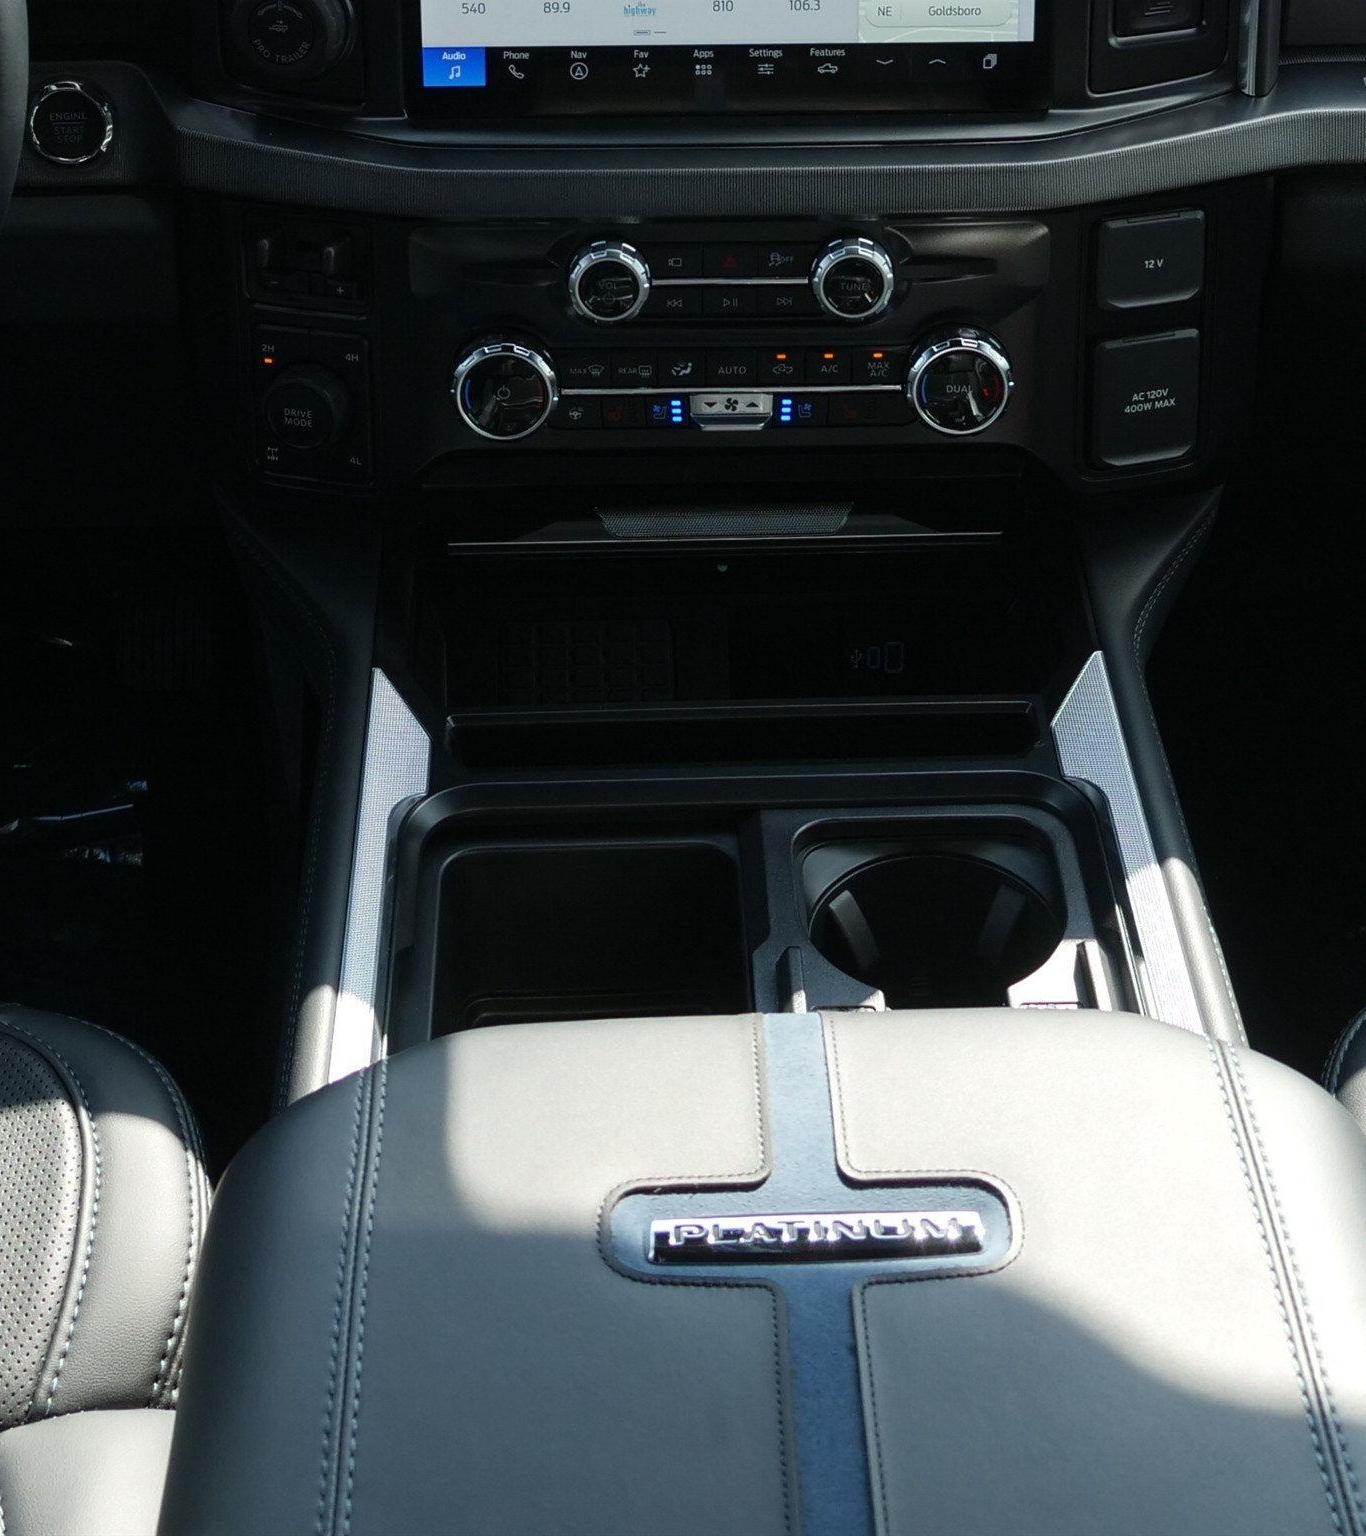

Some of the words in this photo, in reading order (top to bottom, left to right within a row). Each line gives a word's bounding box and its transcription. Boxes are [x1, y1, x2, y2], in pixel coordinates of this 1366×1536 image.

[461, 2, 486, 15] 540
[543, 2, 571, 14] 89.9
[623, 5, 657, 16] highway
[712, 0, 734, 12] 810
[789, 0, 821, 12] 106.3
[877, 6, 892, 16] NE
[928, 5, 982, 17] Goldsboro
[252, 38, 271, 58] PRO
[275, 41, 312, 64] TRAILER
[442, 51, 466, 61] Audio
[503, 50, 530, 61] Phone
[570, 50, 588, 60] Nav
[633, 50, 649, 59] Fav
[692, 49, 714, 61] Apps
[748, 48, 783, 59] Settings
[809, 47, 846, 58] Features
[49, 112, 88, 121] ENGINE
[54, 126, 84, 135] START
[56, 134, 83, 144] STOP
[1144, 259, 1155, 269] 12
[1157, 258, 1164, 268] V
[839, 282, 868, 291] TUNE
[261, 344, 275, 353] 2H
[344, 353, 359, 362] 4H
[717, 366, 747, 375] AUTO
[820, 364, 839, 373] A/C
[867, 362, 890, 370] MAX
[869, 369, 889, 378] A/C
[946, 384, 973, 394] DUAL
[1131, 391, 1145, 402] AC
[1146, 388, 1169, 400] 120V
[1124, 402, 1153, 414] 400W
[1154, 397, 1176, 410] MAX
[283, 407, 312, 419] DRIVE
[283, 417, 314, 428] MODE
[349, 456, 363, 465] 4L
[669, 1217, 965, 1246] PLATINUM
